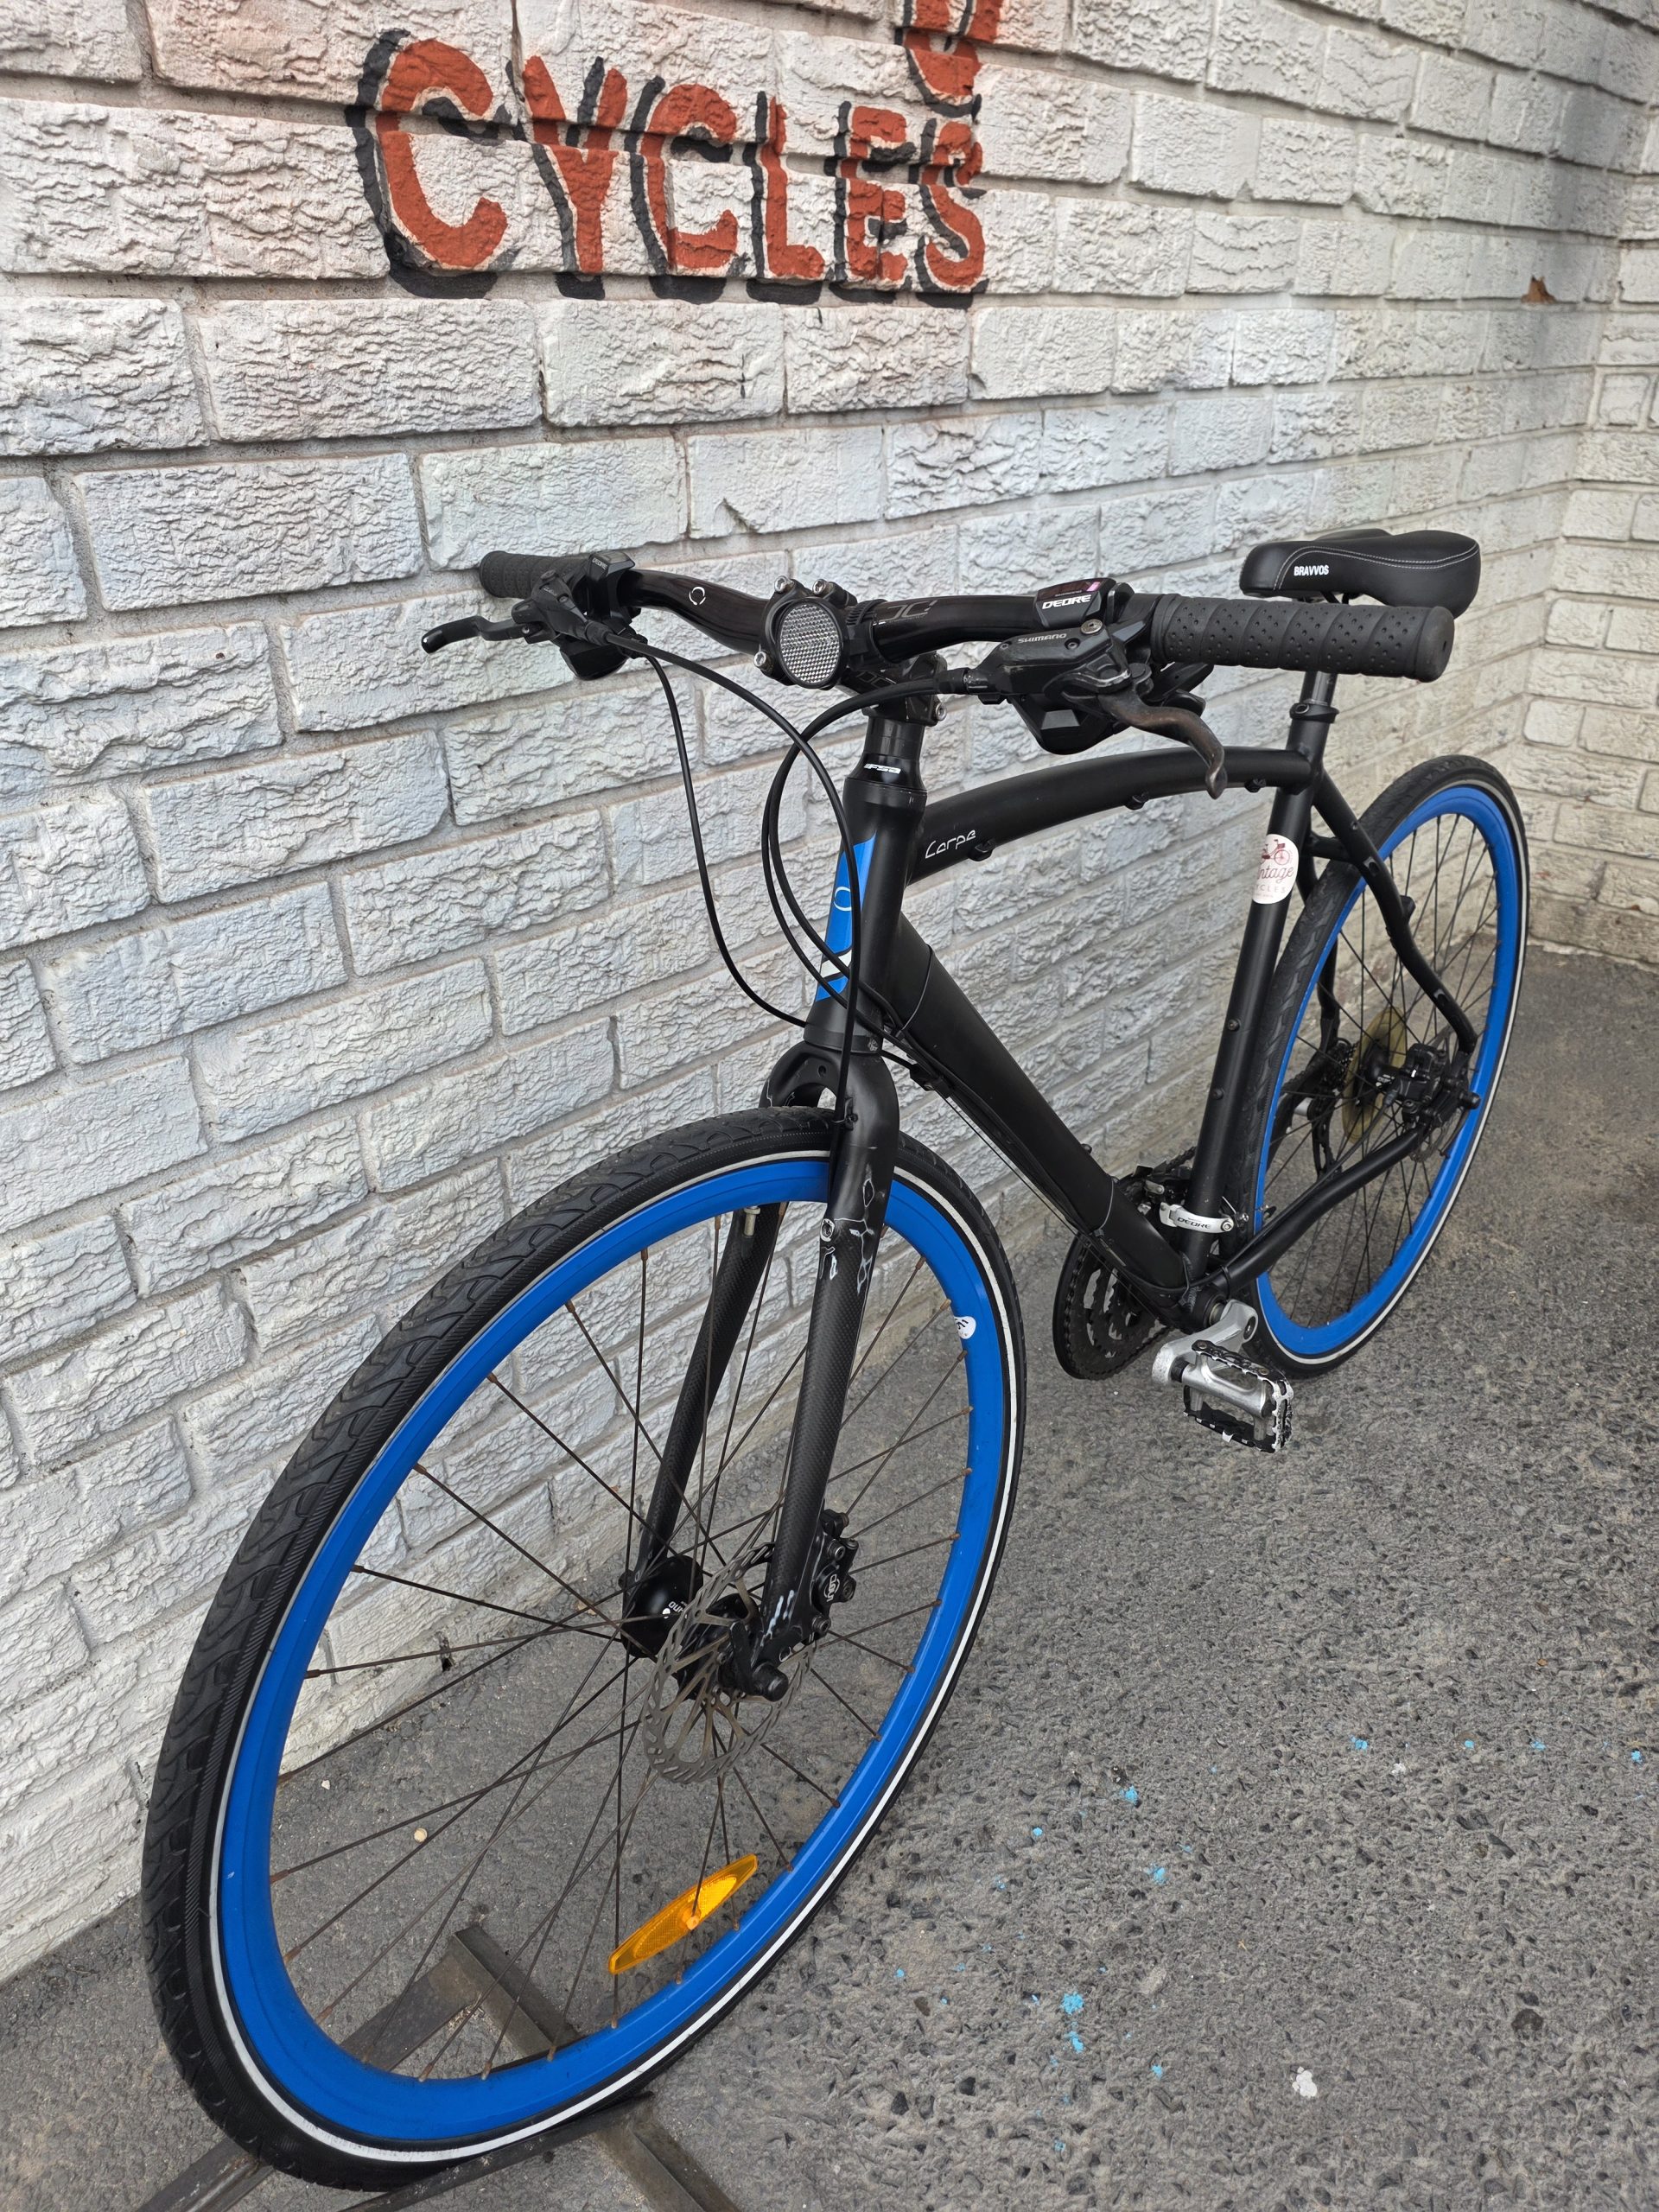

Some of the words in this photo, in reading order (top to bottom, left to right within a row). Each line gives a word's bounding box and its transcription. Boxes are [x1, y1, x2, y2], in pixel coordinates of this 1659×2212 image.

[347, 29, 988, 308] CYCLES
[1294, 564, 1330, 576] BRAVVOS
[1042, 594, 1092, 610] DEORE
[1018, 633, 1067, 644] SHIMANO
[925, 830, 976, 859] Carpe
[1257, 865, 1294, 883] ntage
[1177, 1217, 1211, 1230] DEORE
